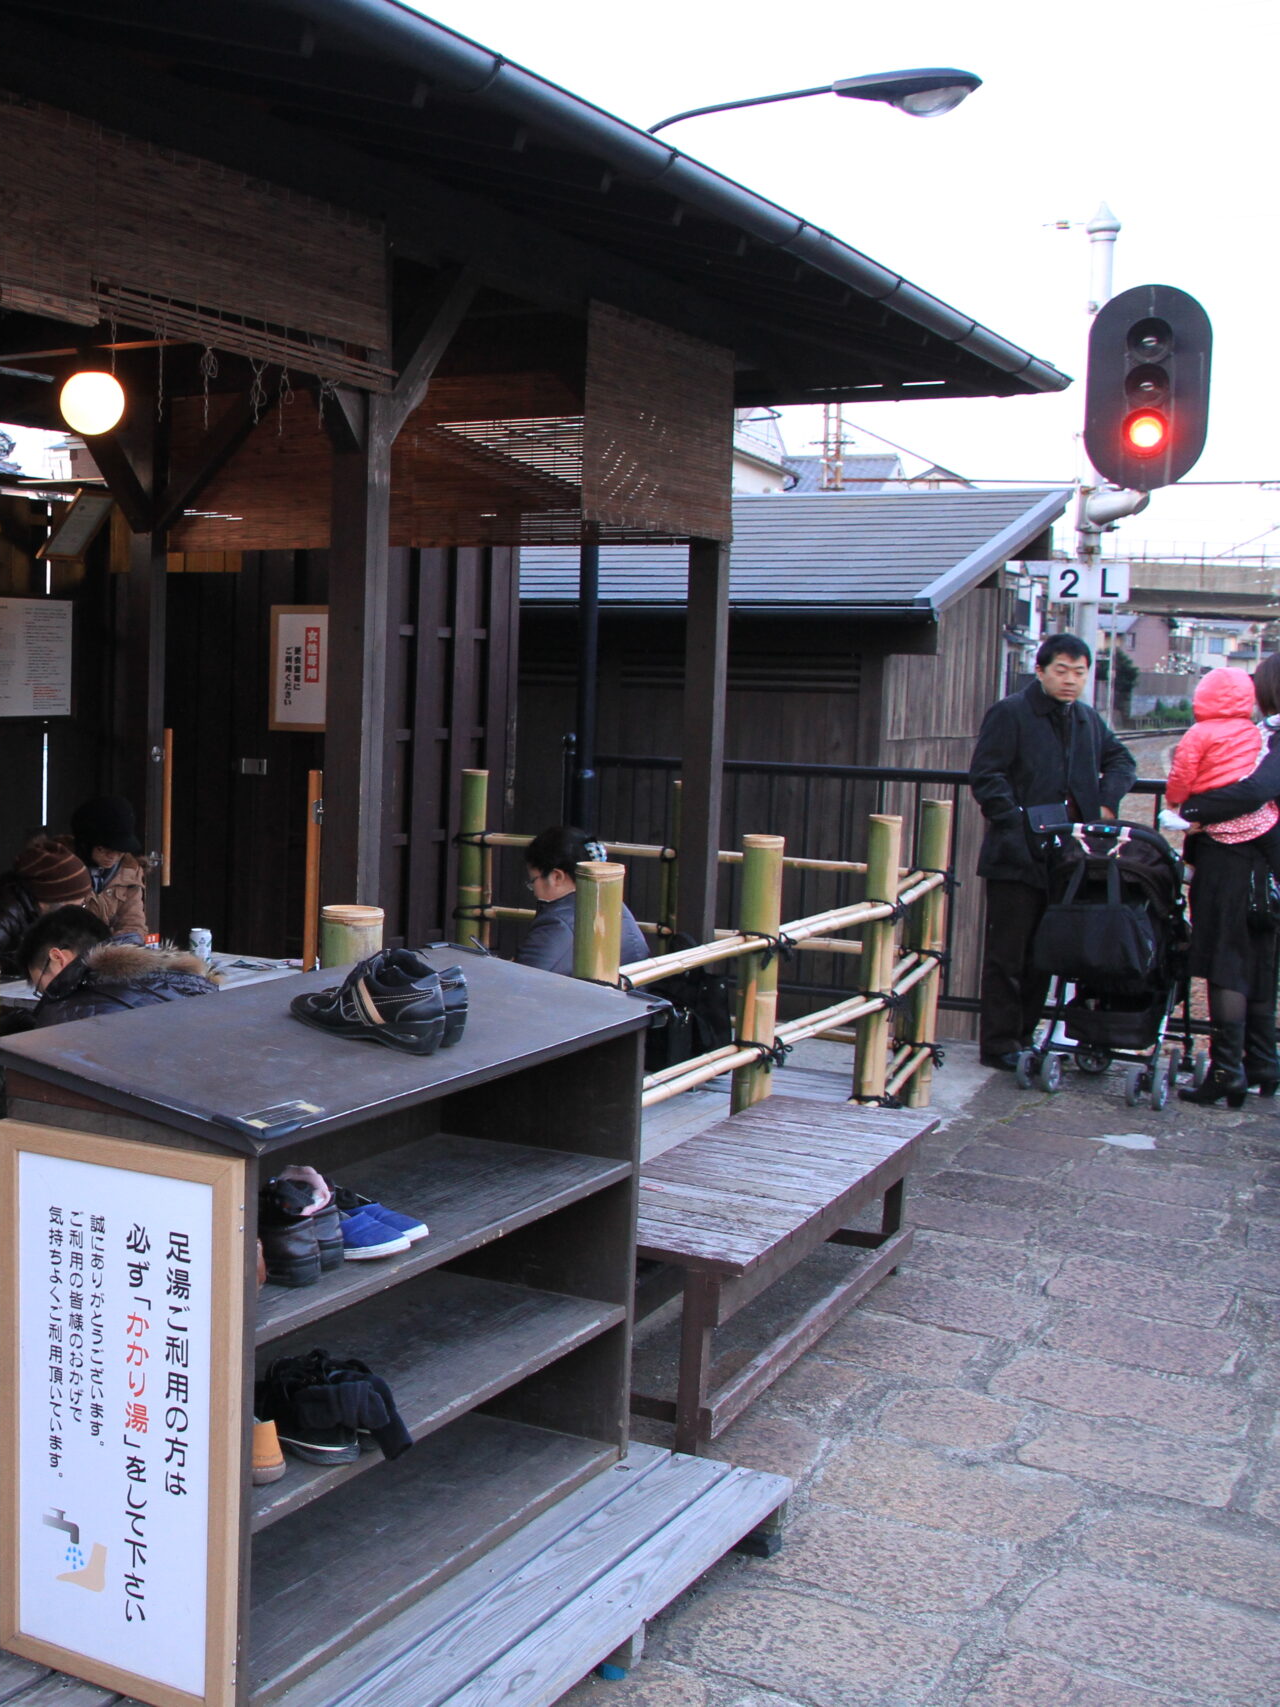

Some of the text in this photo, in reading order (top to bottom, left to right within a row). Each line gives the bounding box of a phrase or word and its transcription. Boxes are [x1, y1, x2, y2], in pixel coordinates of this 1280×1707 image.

[306, 630, 319, 680] 女性専用
[1059, 567, 1120, 598] 2 L
[47, 1204, 64, 1480] 気持ちよくご利用頂いています。
[68, 1209, 85, 1424] ご利用の皆様のおかげで
[89, 1213, 107, 1449] 誠にありがとうございます。
[123, 1220, 152, 1624] 必ず「かかり湯」をして下さい
[164, 1230, 192, 1497] 足湯ご利用の方は
